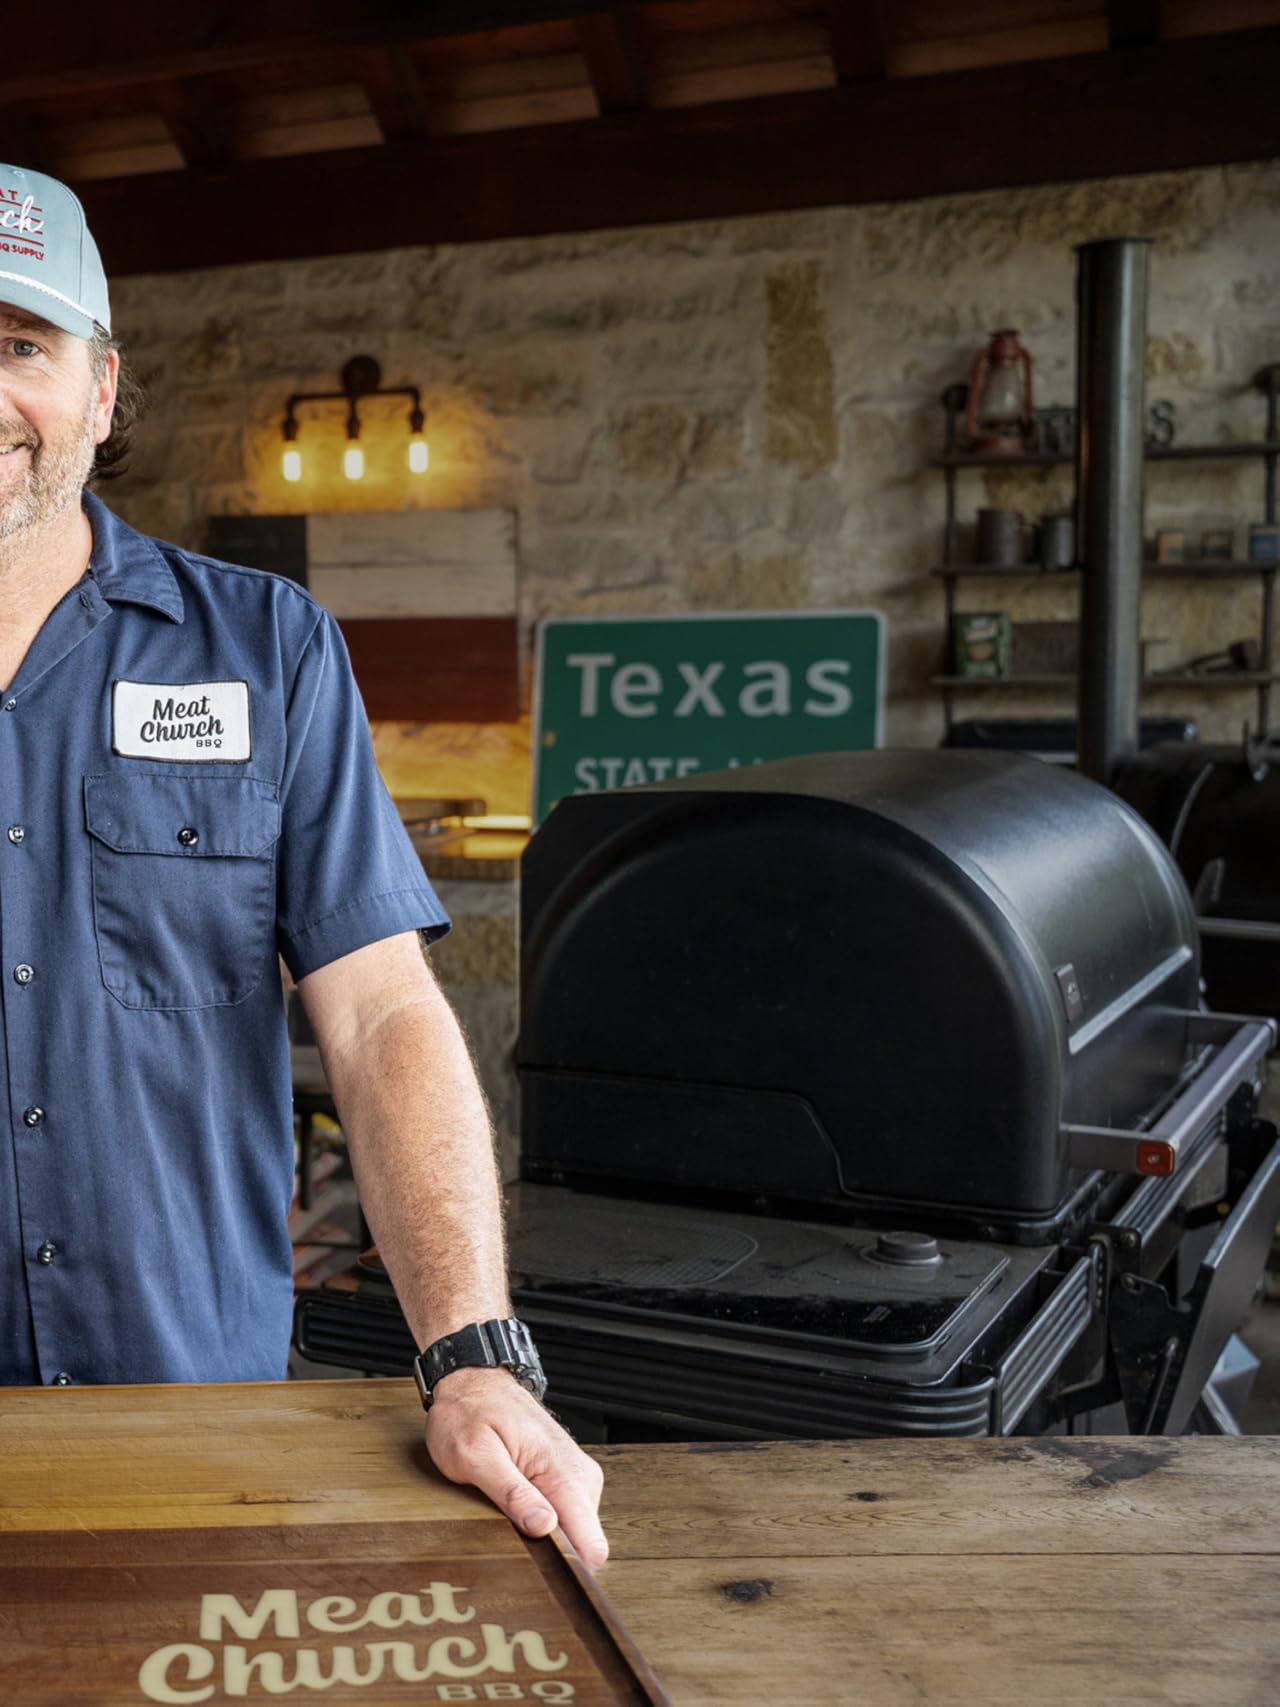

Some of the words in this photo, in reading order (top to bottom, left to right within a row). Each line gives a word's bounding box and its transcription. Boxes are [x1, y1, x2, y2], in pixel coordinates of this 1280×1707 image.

[11, 242, 45, 261] SUPPLY
[566, 651, 854, 718] Texas
[152, 695, 211, 721] Meat
[139, 714, 224, 743] Church
[195, 738, 223, 749] BBQ
[199, 1581, 476, 1642] Meat
[138, 1623, 569, 1704] Church
[436, 1680, 576, 1704] BBQ
